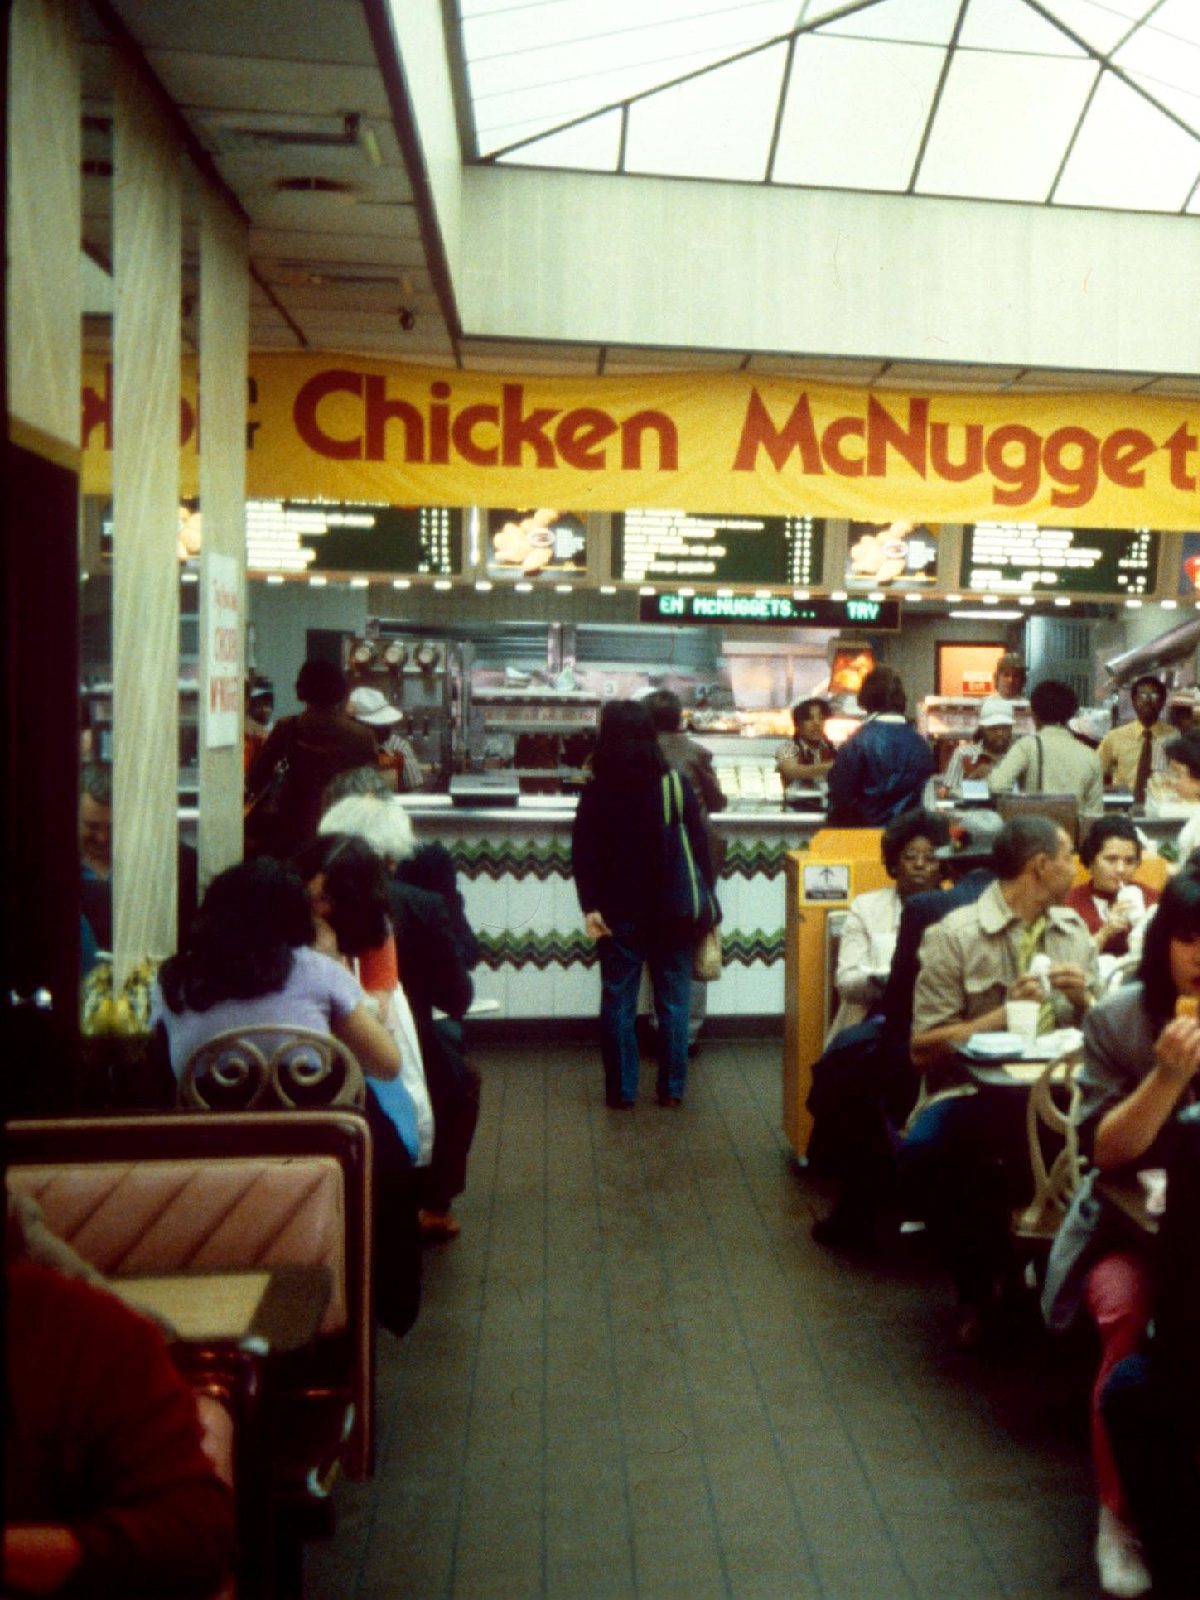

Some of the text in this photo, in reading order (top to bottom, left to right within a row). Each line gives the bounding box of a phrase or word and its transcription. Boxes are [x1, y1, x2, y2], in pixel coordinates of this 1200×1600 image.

[293, 369, 679, 471] Chicken
[659, 595, 684, 615] EN
[847, 601, 880, 621] TRY
